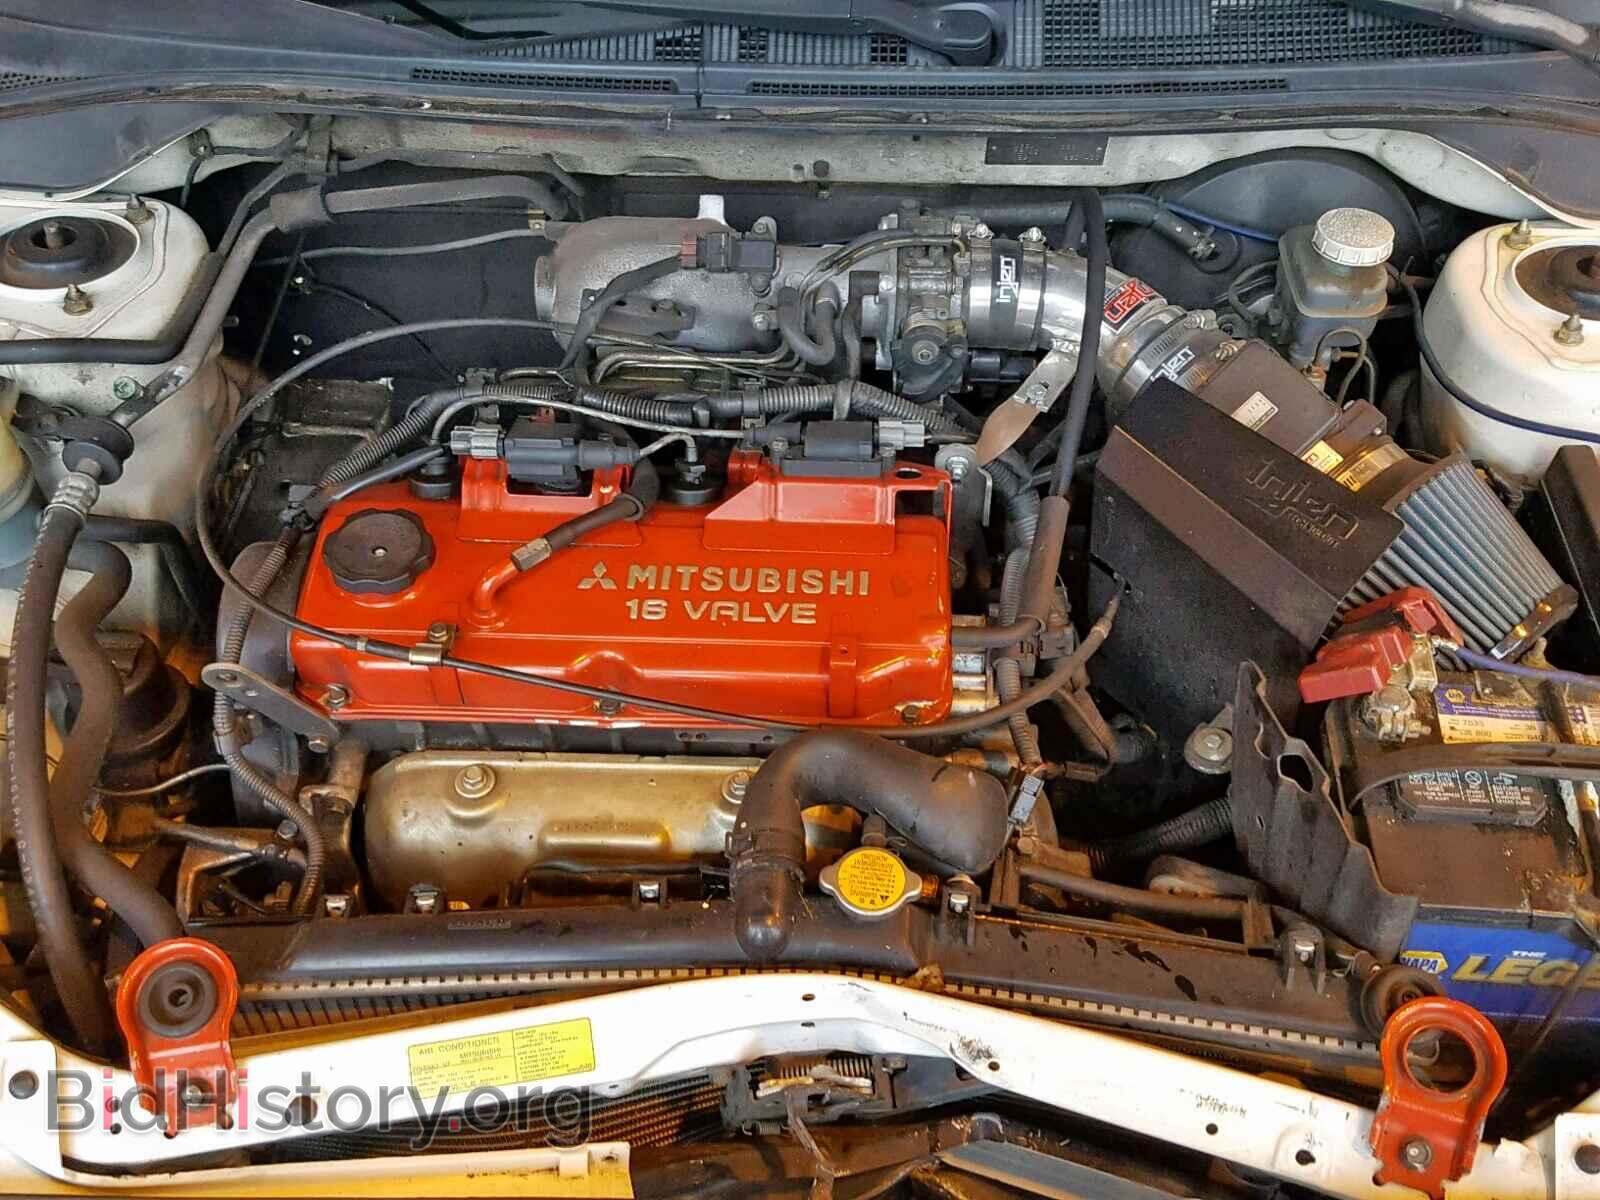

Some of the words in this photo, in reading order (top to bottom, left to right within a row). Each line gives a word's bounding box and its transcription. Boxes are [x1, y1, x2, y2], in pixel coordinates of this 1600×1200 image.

[626, 564, 870, 596] MITSUBISHI
[625, 598, 668, 621] 16
[683, 599, 817, 624] VALVE
